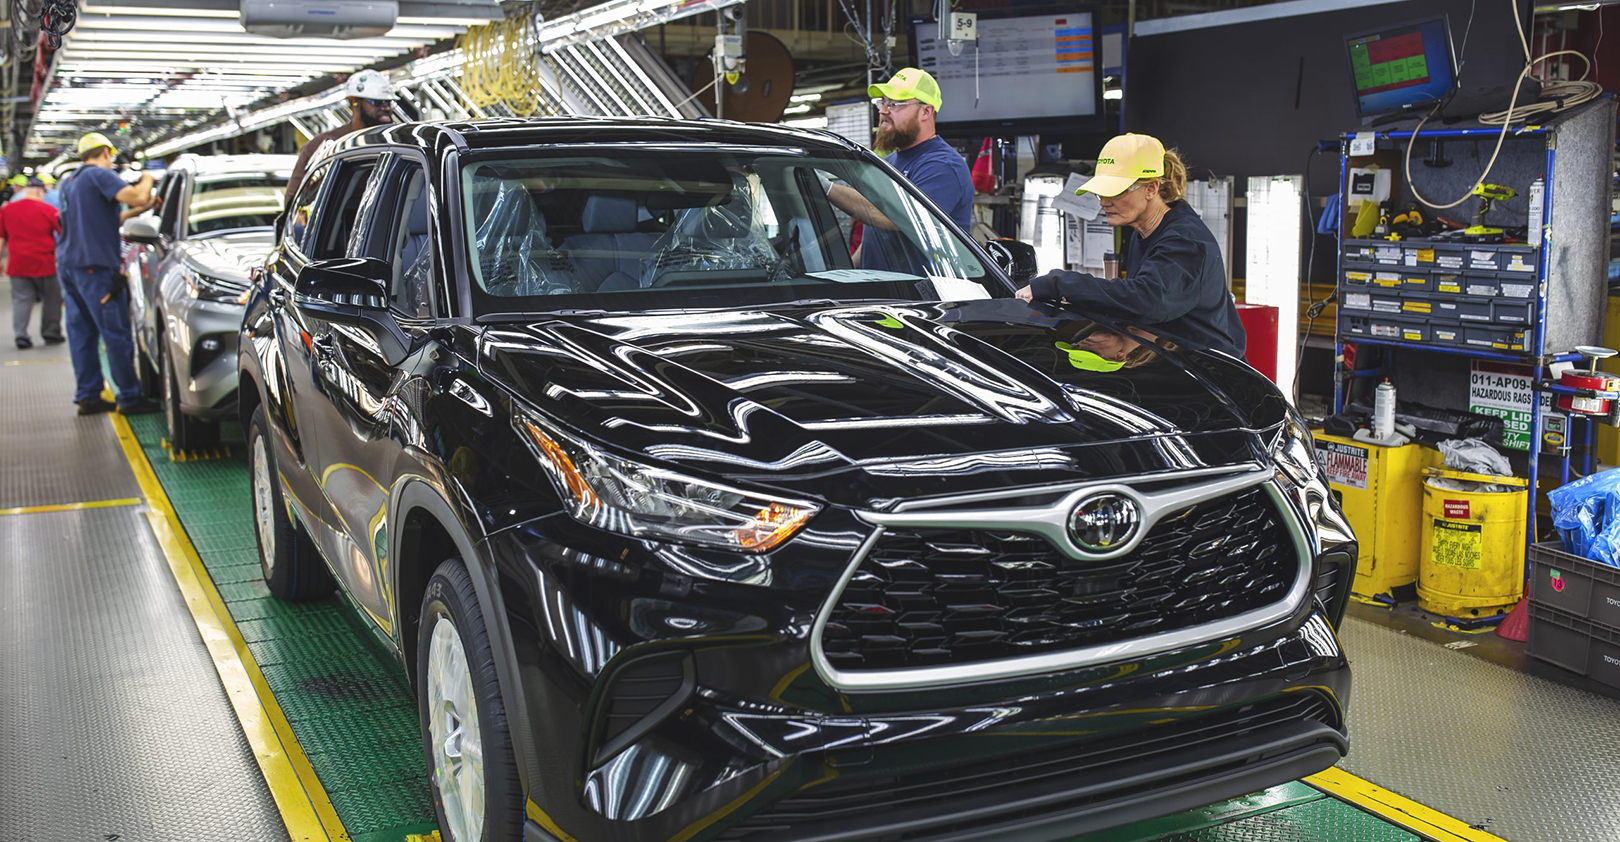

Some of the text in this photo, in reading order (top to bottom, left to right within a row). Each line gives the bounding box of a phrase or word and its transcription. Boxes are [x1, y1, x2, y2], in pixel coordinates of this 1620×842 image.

[957, 18, 972, 28] 5-9
[1471, 387, 1552, 407] HAZARDOUS RAGS DE
[1511, 411, 1532, 421] LID
[1503, 419, 1528, 431] SED
[1503, 431, 1519, 440] TY
[1335, 444, 1365, 457] JUSTRITE
[1326, 451, 1367, 474] FLAMMABLE
[1326, 466, 1366, 481] KEEP FIRE AWAY
[1554, 578, 1562, 589] 13
